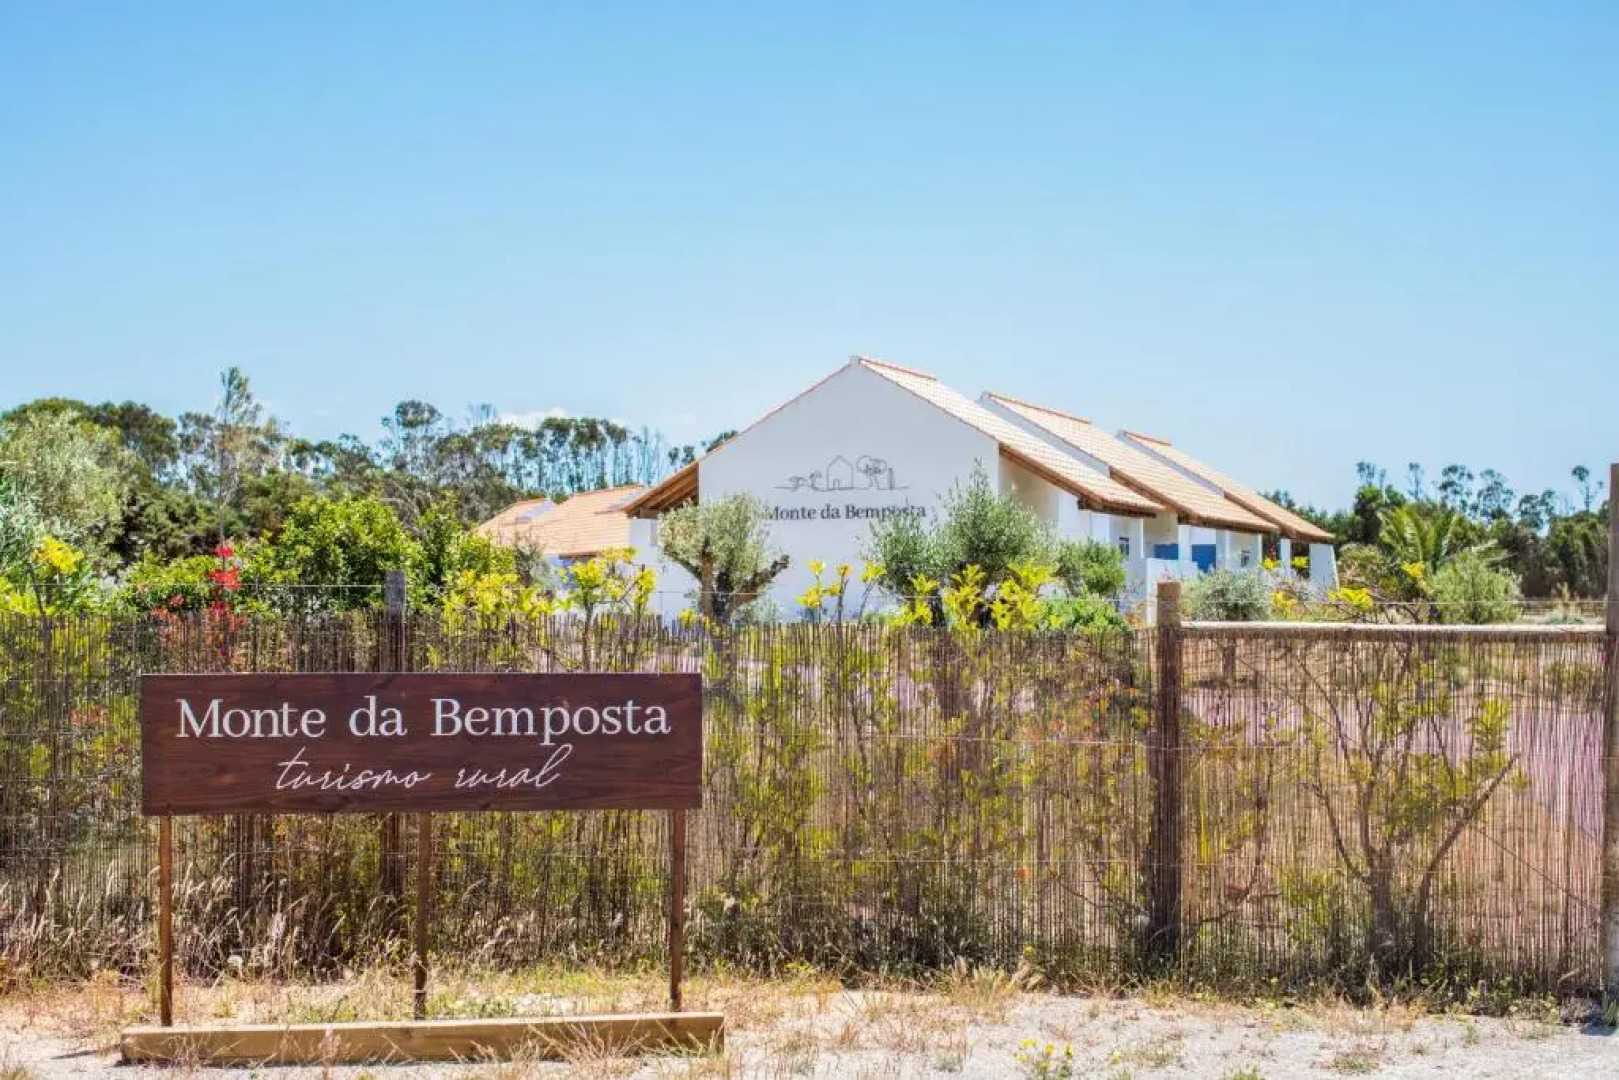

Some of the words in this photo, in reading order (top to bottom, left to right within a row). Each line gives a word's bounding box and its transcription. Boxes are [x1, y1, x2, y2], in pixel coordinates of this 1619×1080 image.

[820, 503, 841, 520] da
[844, 504, 926, 522] Bemposta
[176, 698, 326, 738] Monte
[348, 695, 408, 736] da
[430, 698, 671, 746] Bemposta
[276, 746, 431, 790] turismo
[455, 744, 573, 788] rural
